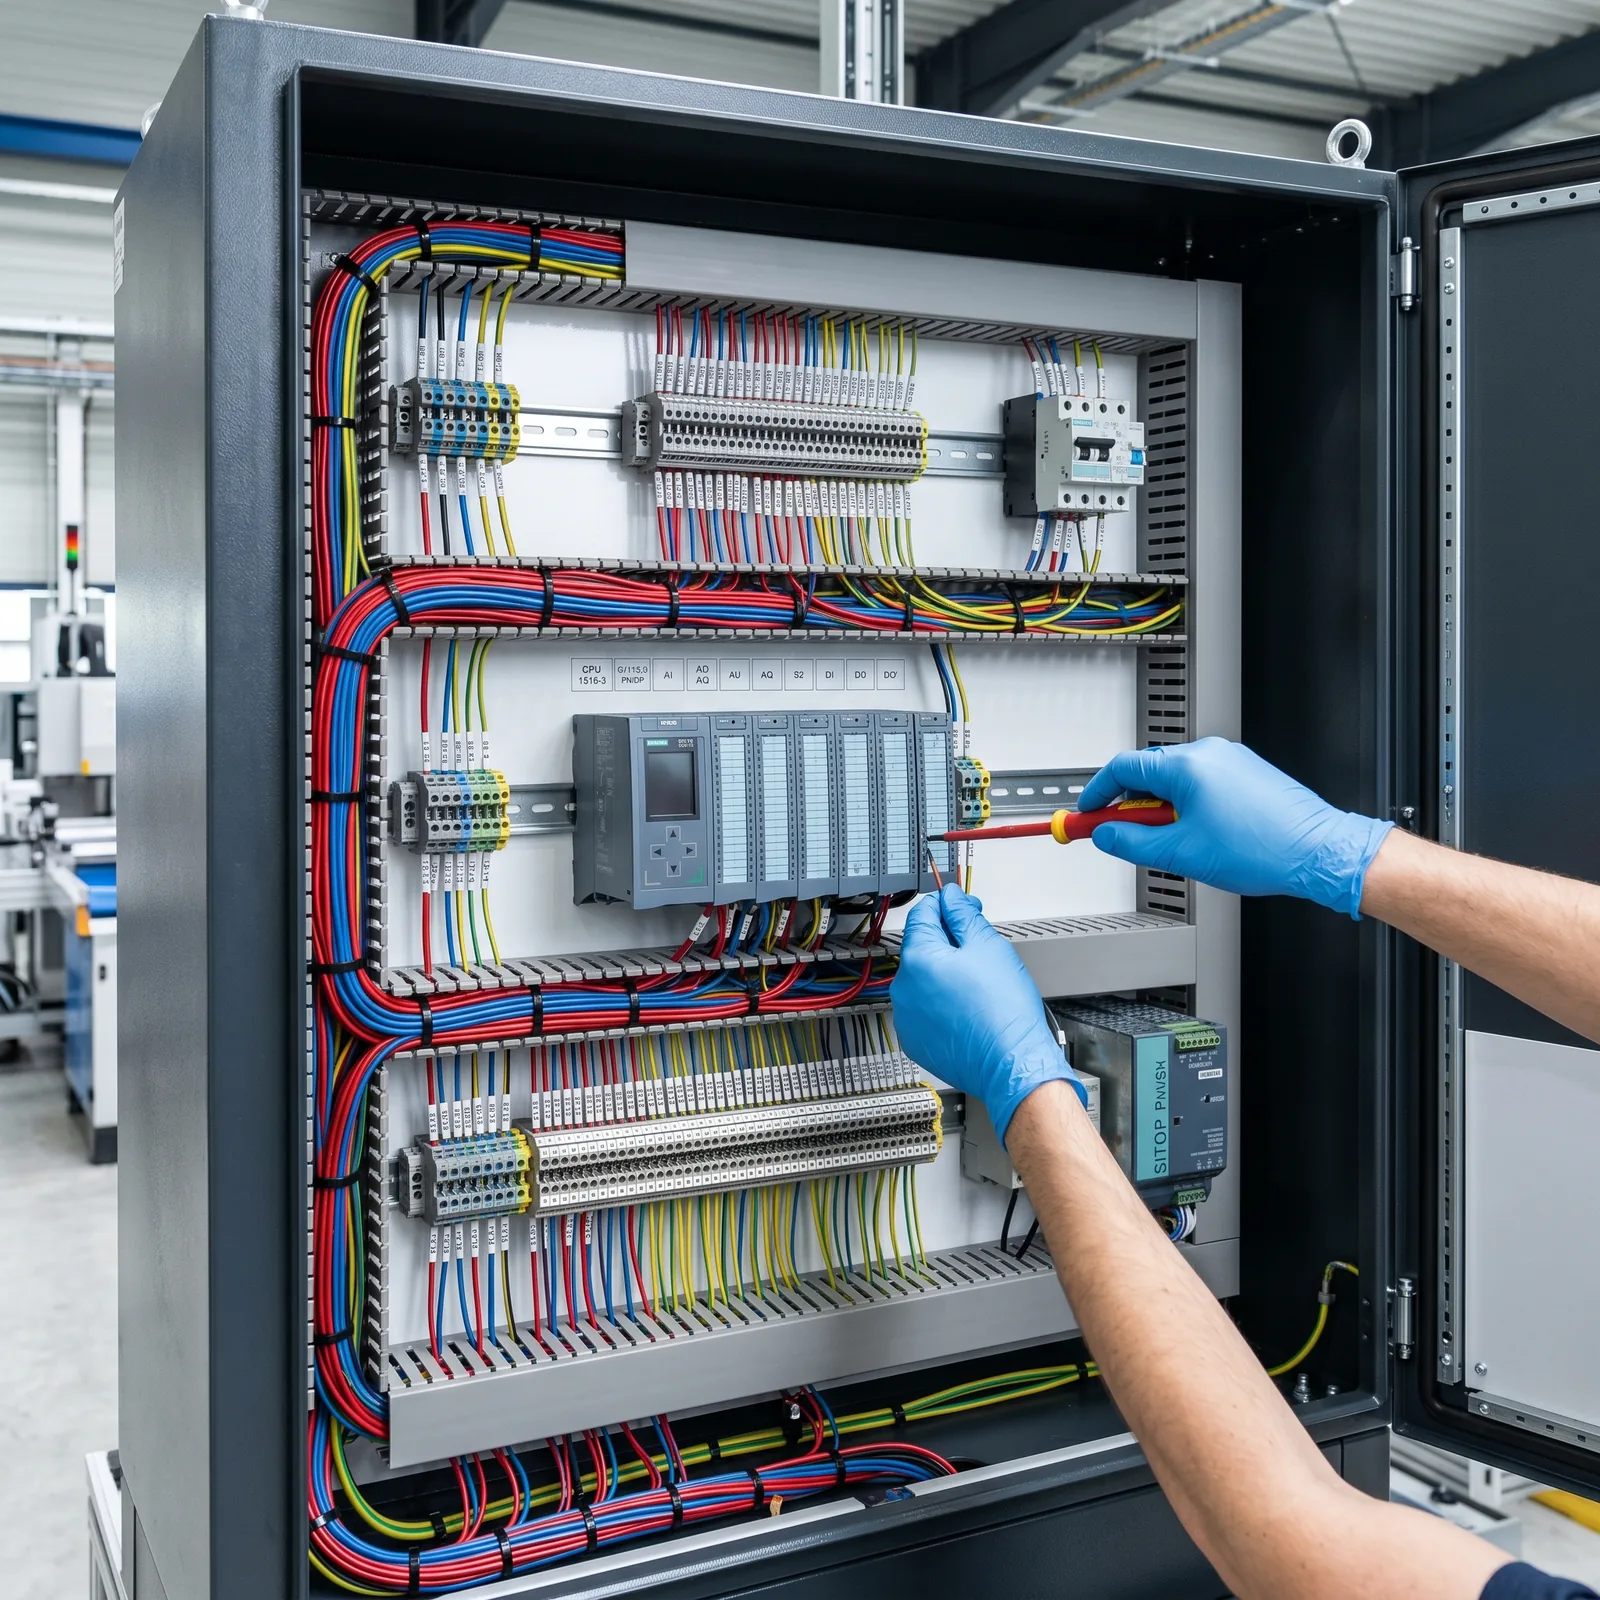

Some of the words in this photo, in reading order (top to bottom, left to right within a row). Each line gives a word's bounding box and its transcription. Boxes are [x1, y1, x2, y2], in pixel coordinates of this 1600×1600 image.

[581, 665, 601, 674] CPU
[695, 665, 710, 674] AD
[663, 671, 673, 680] AI
[728, 671, 742, 680] AU
[760, 671, 774, 680] AQ
[793, 671, 805, 679] S2
[825, 671, 835, 679] DI
[578, 676, 607, 685] 1516-3
[695, 676, 710, 685] AQ
[1154, 1119, 1167, 1174] SITOP
